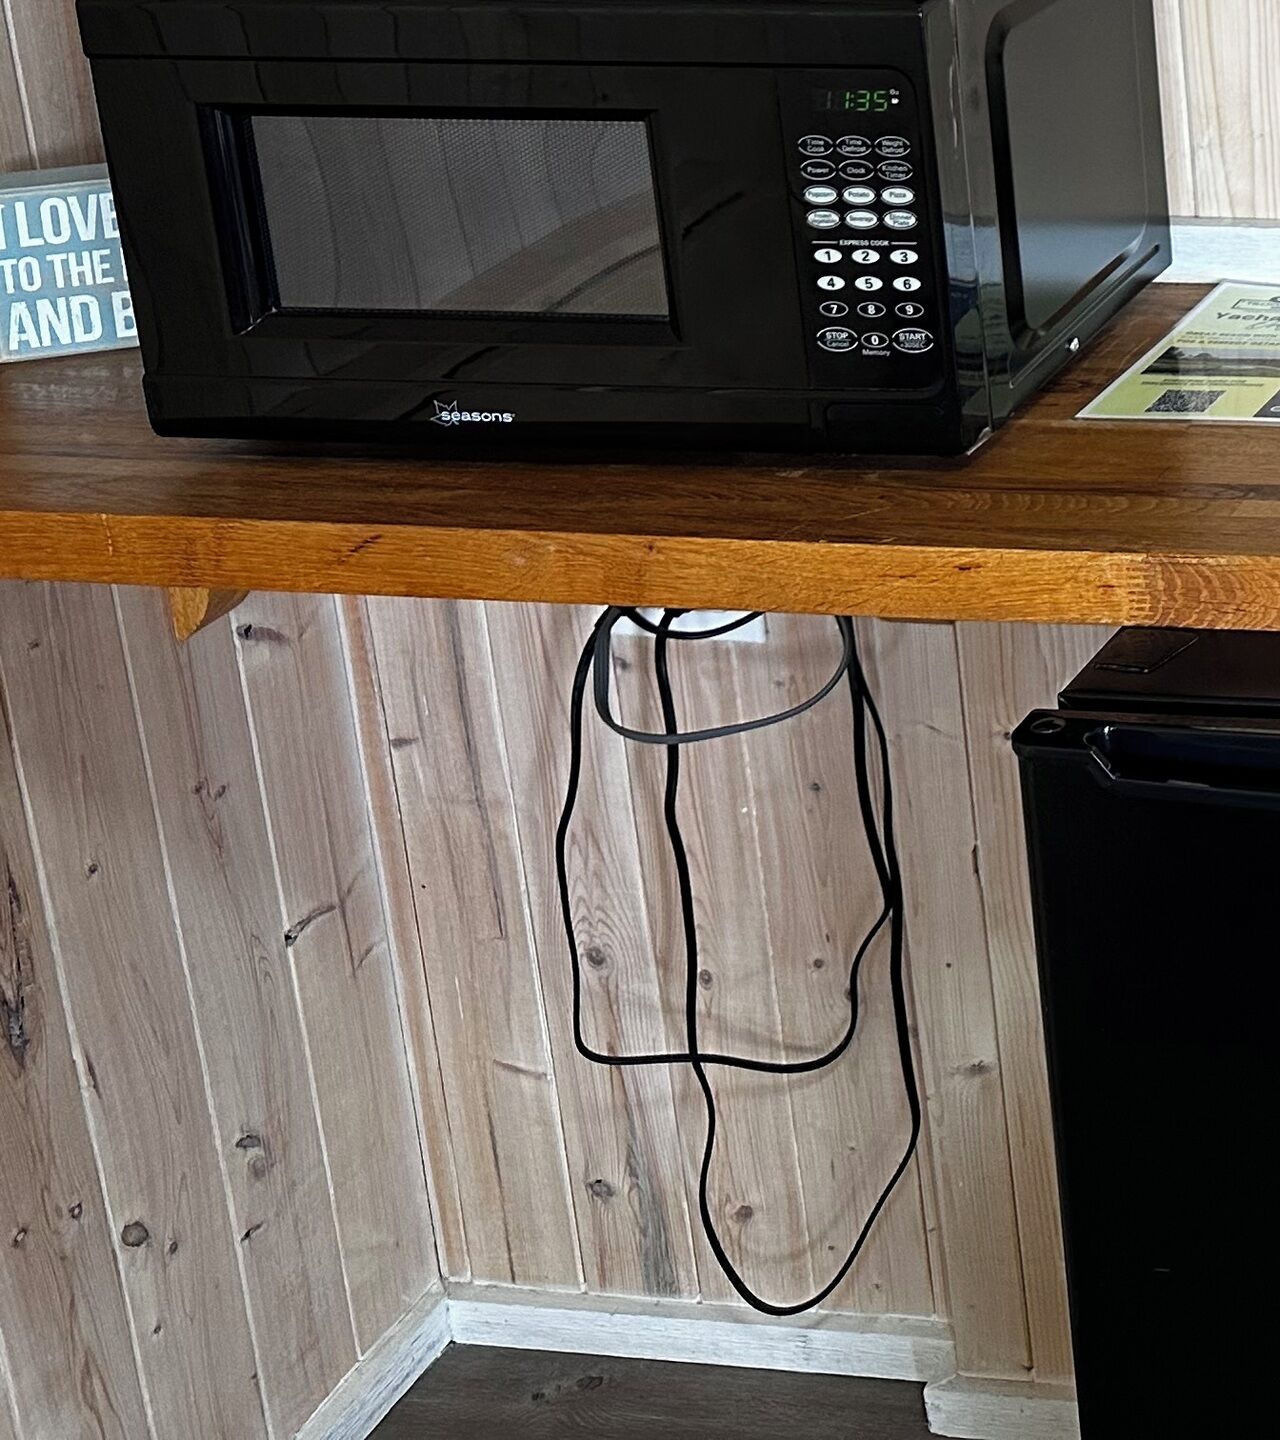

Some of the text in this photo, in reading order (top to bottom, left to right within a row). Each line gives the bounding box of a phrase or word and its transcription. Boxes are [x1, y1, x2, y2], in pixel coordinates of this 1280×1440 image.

[844, 90, 888, 111] 1:35
[14, 192, 120, 248] LOVE
[824, 250, 909, 263] 1 2 3
[0, 256, 41, 294] TO
[46, 249, 115, 289] THE
[826, 277, 912, 290] 4 5 6
[830, 304, 914, 315] 7 8 9
[9, 295, 103, 350] AND
[825, 331, 849, 340] STOP
[870, 334, 879, 346] 0
[898, 332, 926, 340] START
[441, 411, 513, 422] seasons
